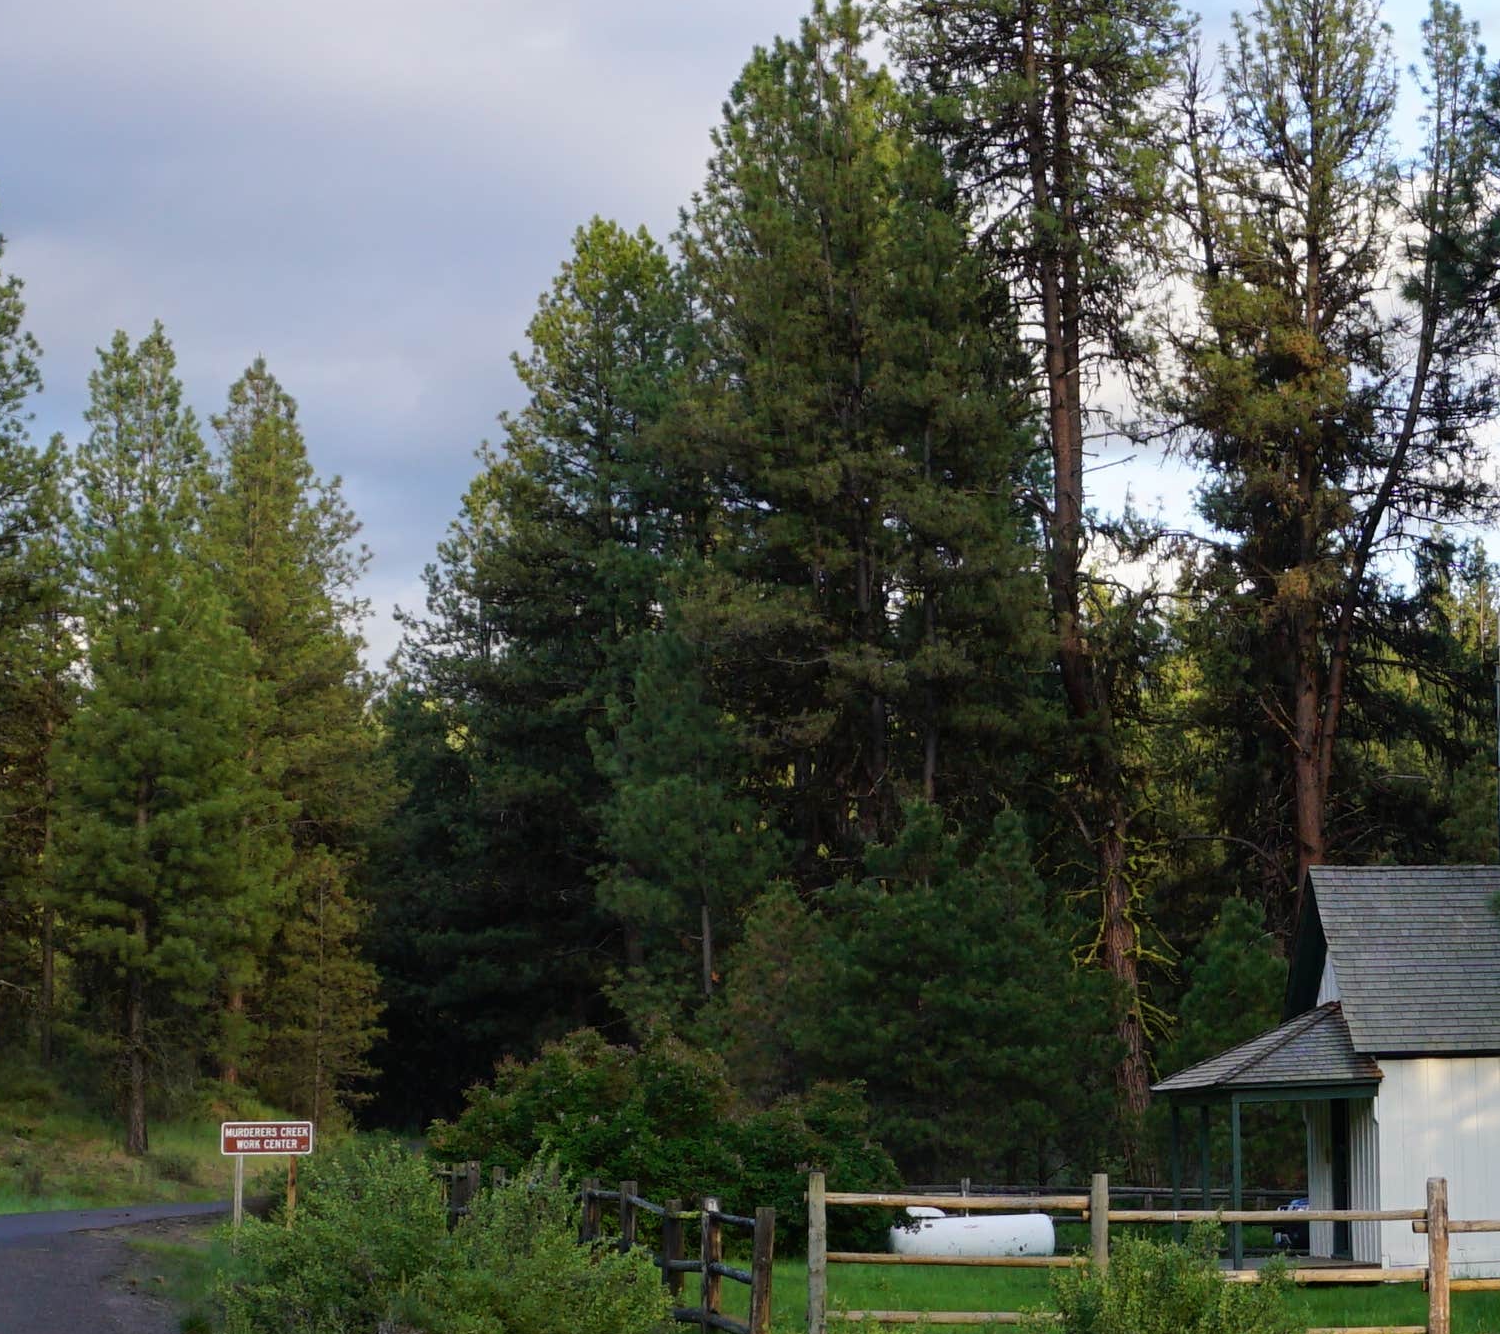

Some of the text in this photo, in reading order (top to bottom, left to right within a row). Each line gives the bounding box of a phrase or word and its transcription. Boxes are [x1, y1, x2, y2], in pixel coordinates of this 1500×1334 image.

[225, 1127, 308, 1137] MURDERERS CREEK
[236, 1139, 298, 1149] WORK CENTER
